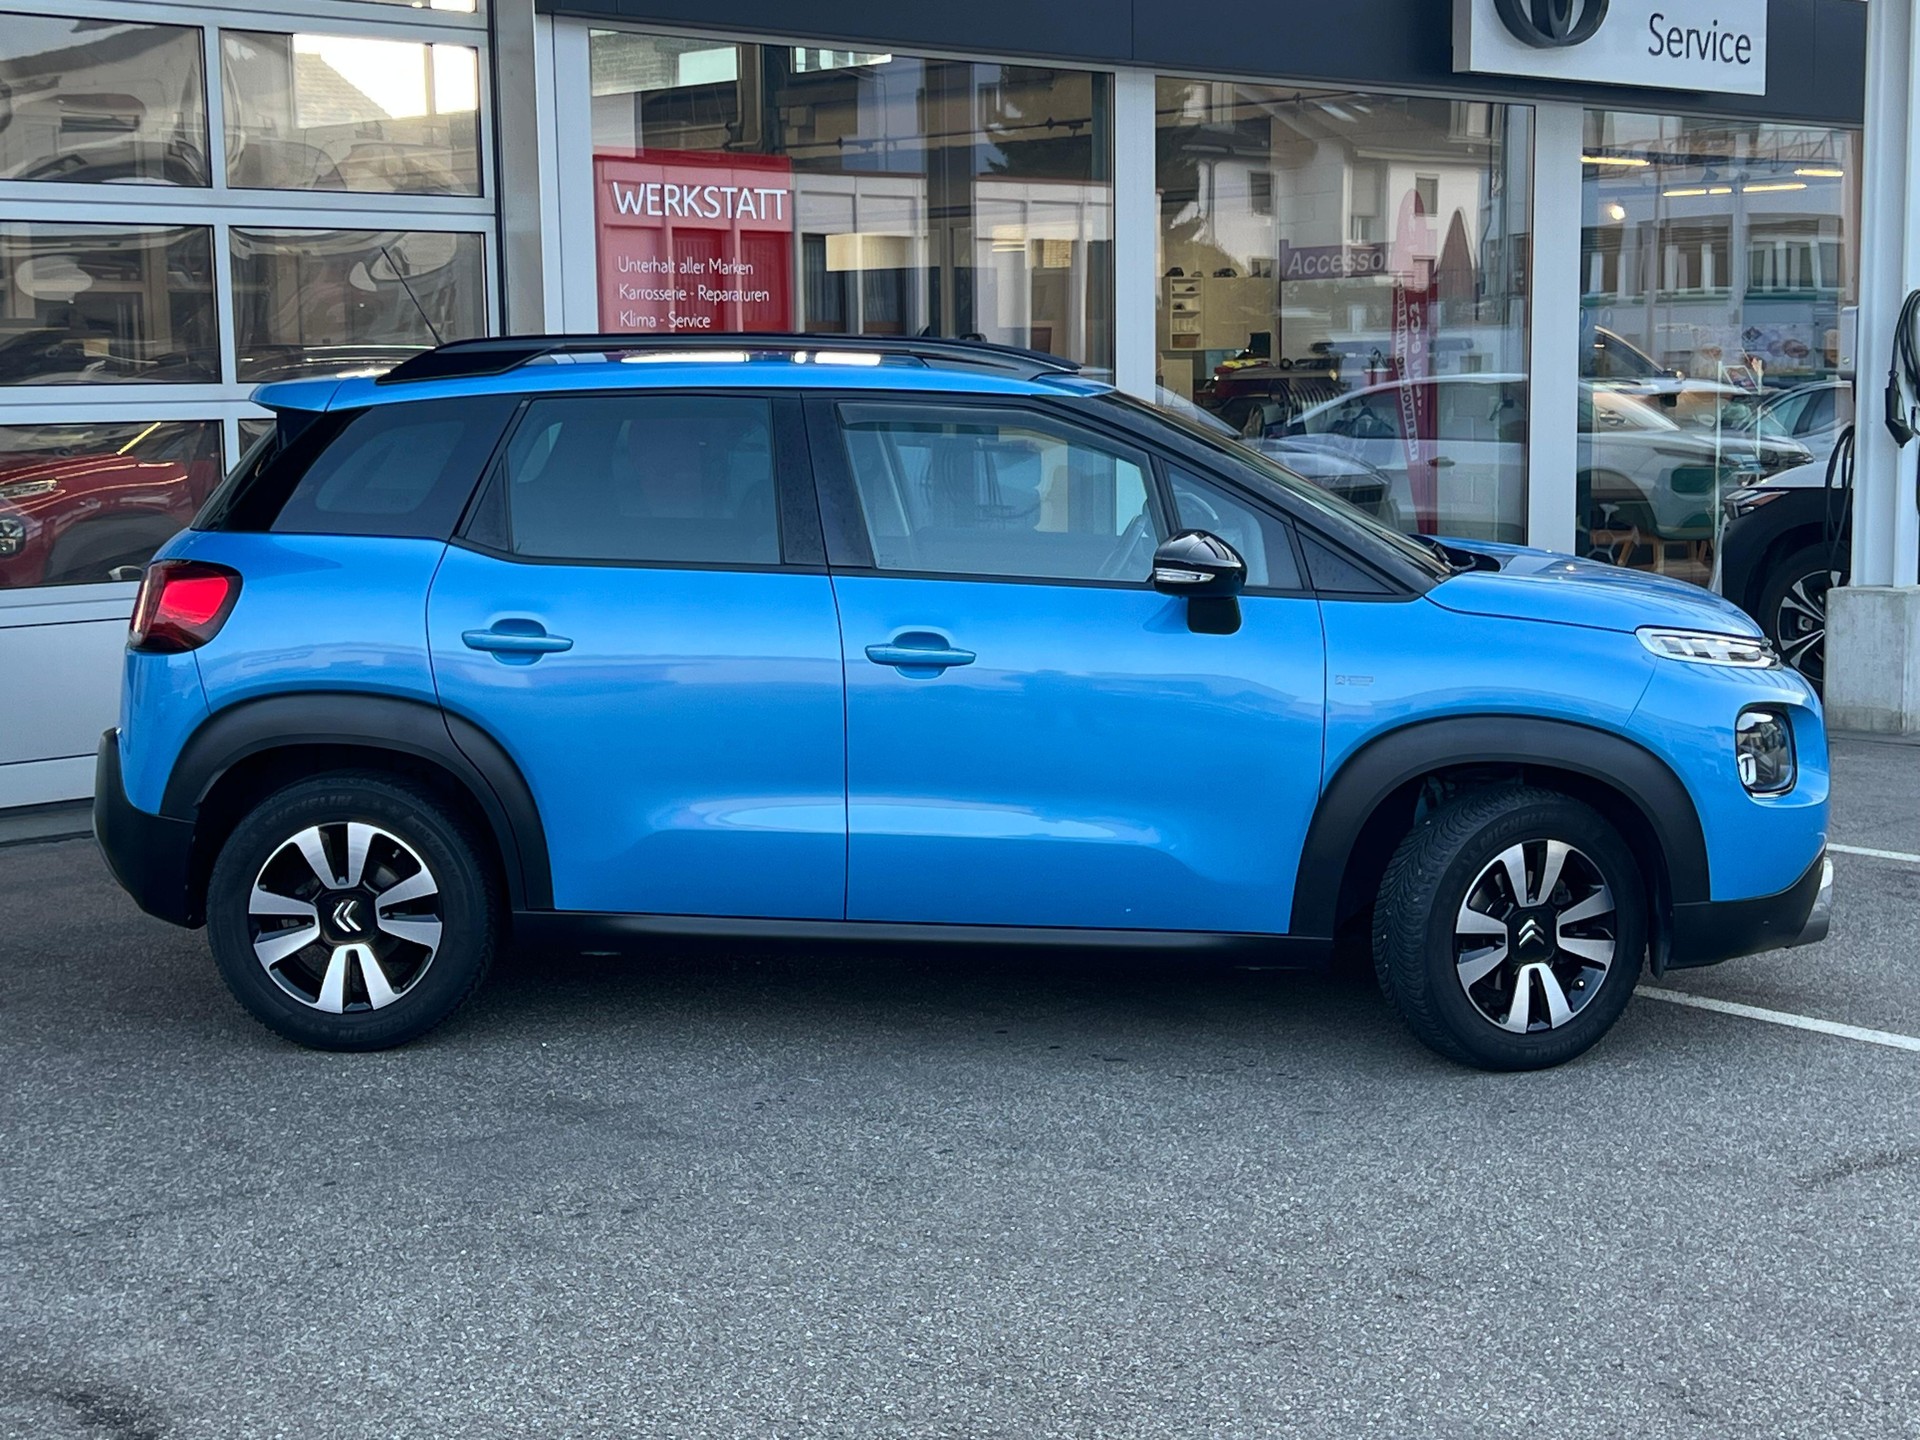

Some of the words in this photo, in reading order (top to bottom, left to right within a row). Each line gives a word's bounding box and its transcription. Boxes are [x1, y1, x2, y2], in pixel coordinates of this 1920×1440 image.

[1648, 13, 1752, 65] Service
[612, 181, 788, 221] WERKSTATT
[617, 255, 676, 274] Unterhalt
[679, 257, 705, 274] aller
[708, 257, 754, 275] Marken
[618, 283, 687, 301] Karrosserie
[697, 284, 770, 304] Reparaturen
[619, 310, 657, 328] Klima
[668, 311, 711, 329] Service
